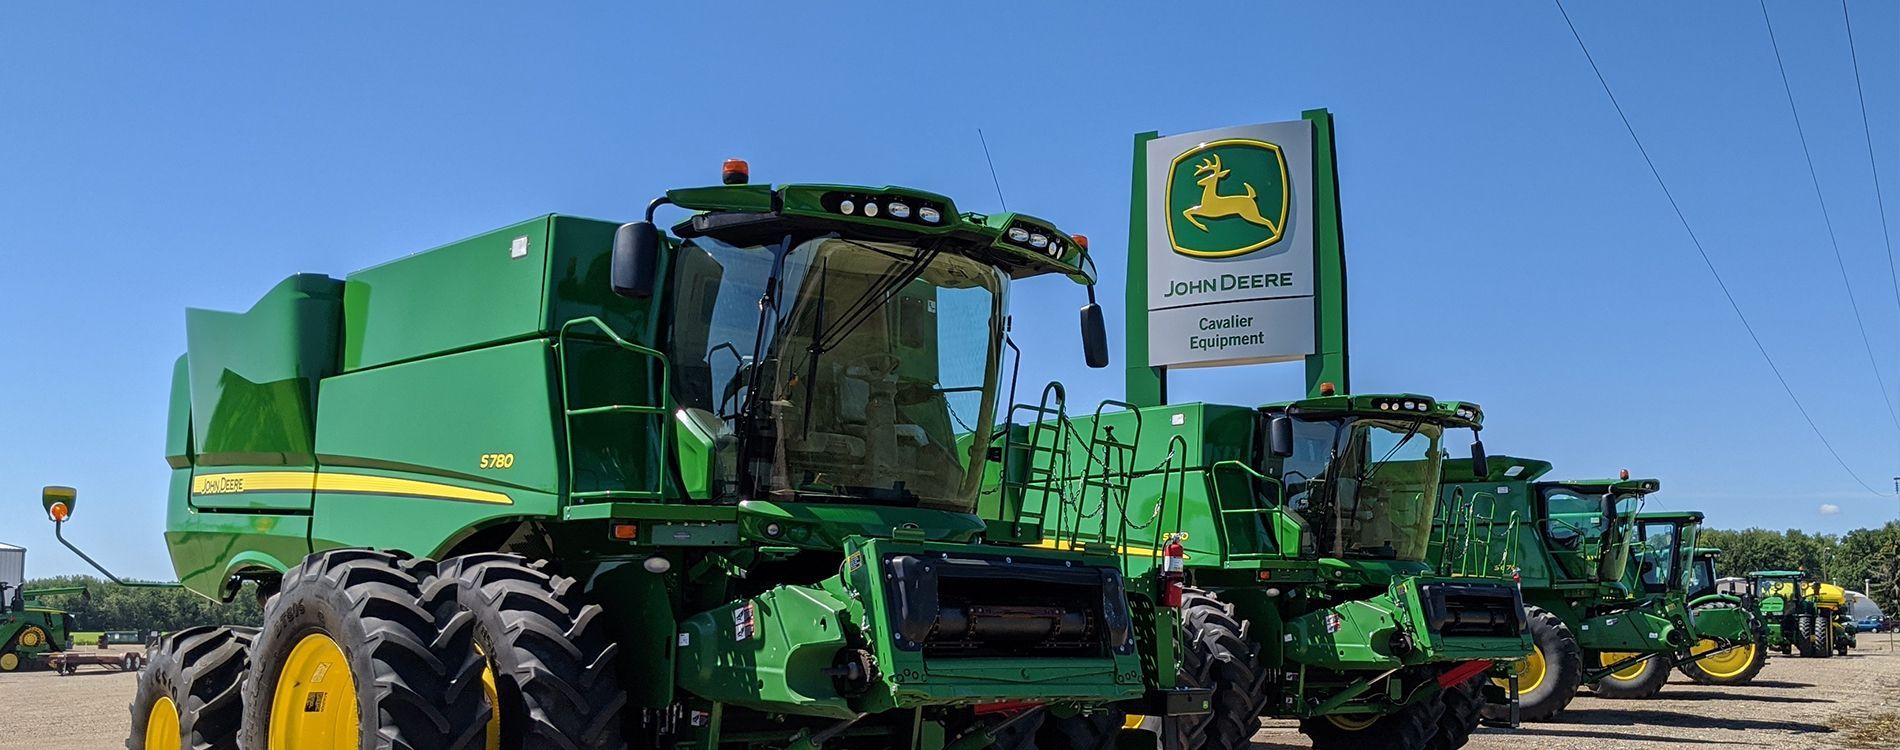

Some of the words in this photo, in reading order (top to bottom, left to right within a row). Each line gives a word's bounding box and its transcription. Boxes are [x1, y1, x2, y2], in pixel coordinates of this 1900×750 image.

[1164, 278, 1217, 297] JOHN
[1220, 272, 1293, 292] DEERE
[1199, 315, 1253, 331] Cavalier
[1190, 331, 1264, 351] Equipment
[480, 453, 514, 469] S780
[201, 478, 220, 493] JOHN
[220, 477, 244, 491] DEERE
[1163, 531, 1189, 541] S70
